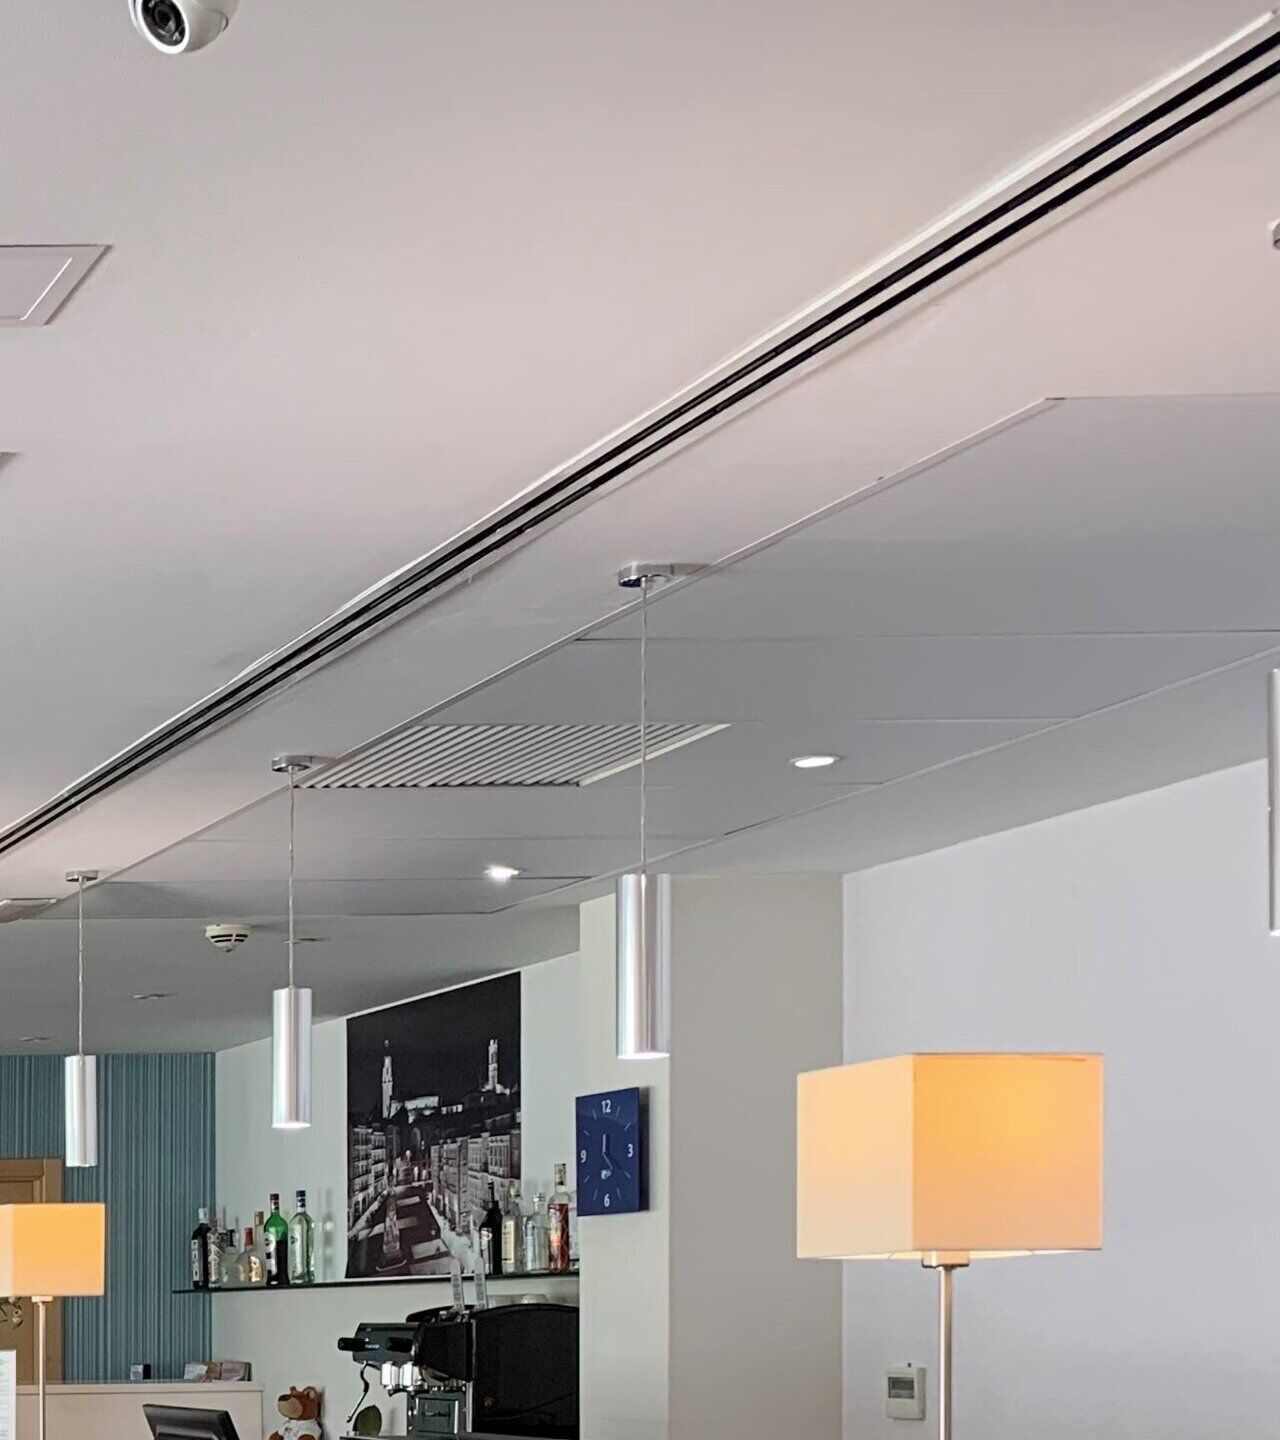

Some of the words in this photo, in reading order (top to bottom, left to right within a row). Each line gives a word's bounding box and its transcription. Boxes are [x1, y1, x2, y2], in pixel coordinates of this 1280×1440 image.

[601, 1100, 612, 1114] 12
[580, 1150, 587, 1163] 9
[627, 1144, 634, 1158] 3
[603, 1193, 610, 1207] 6
